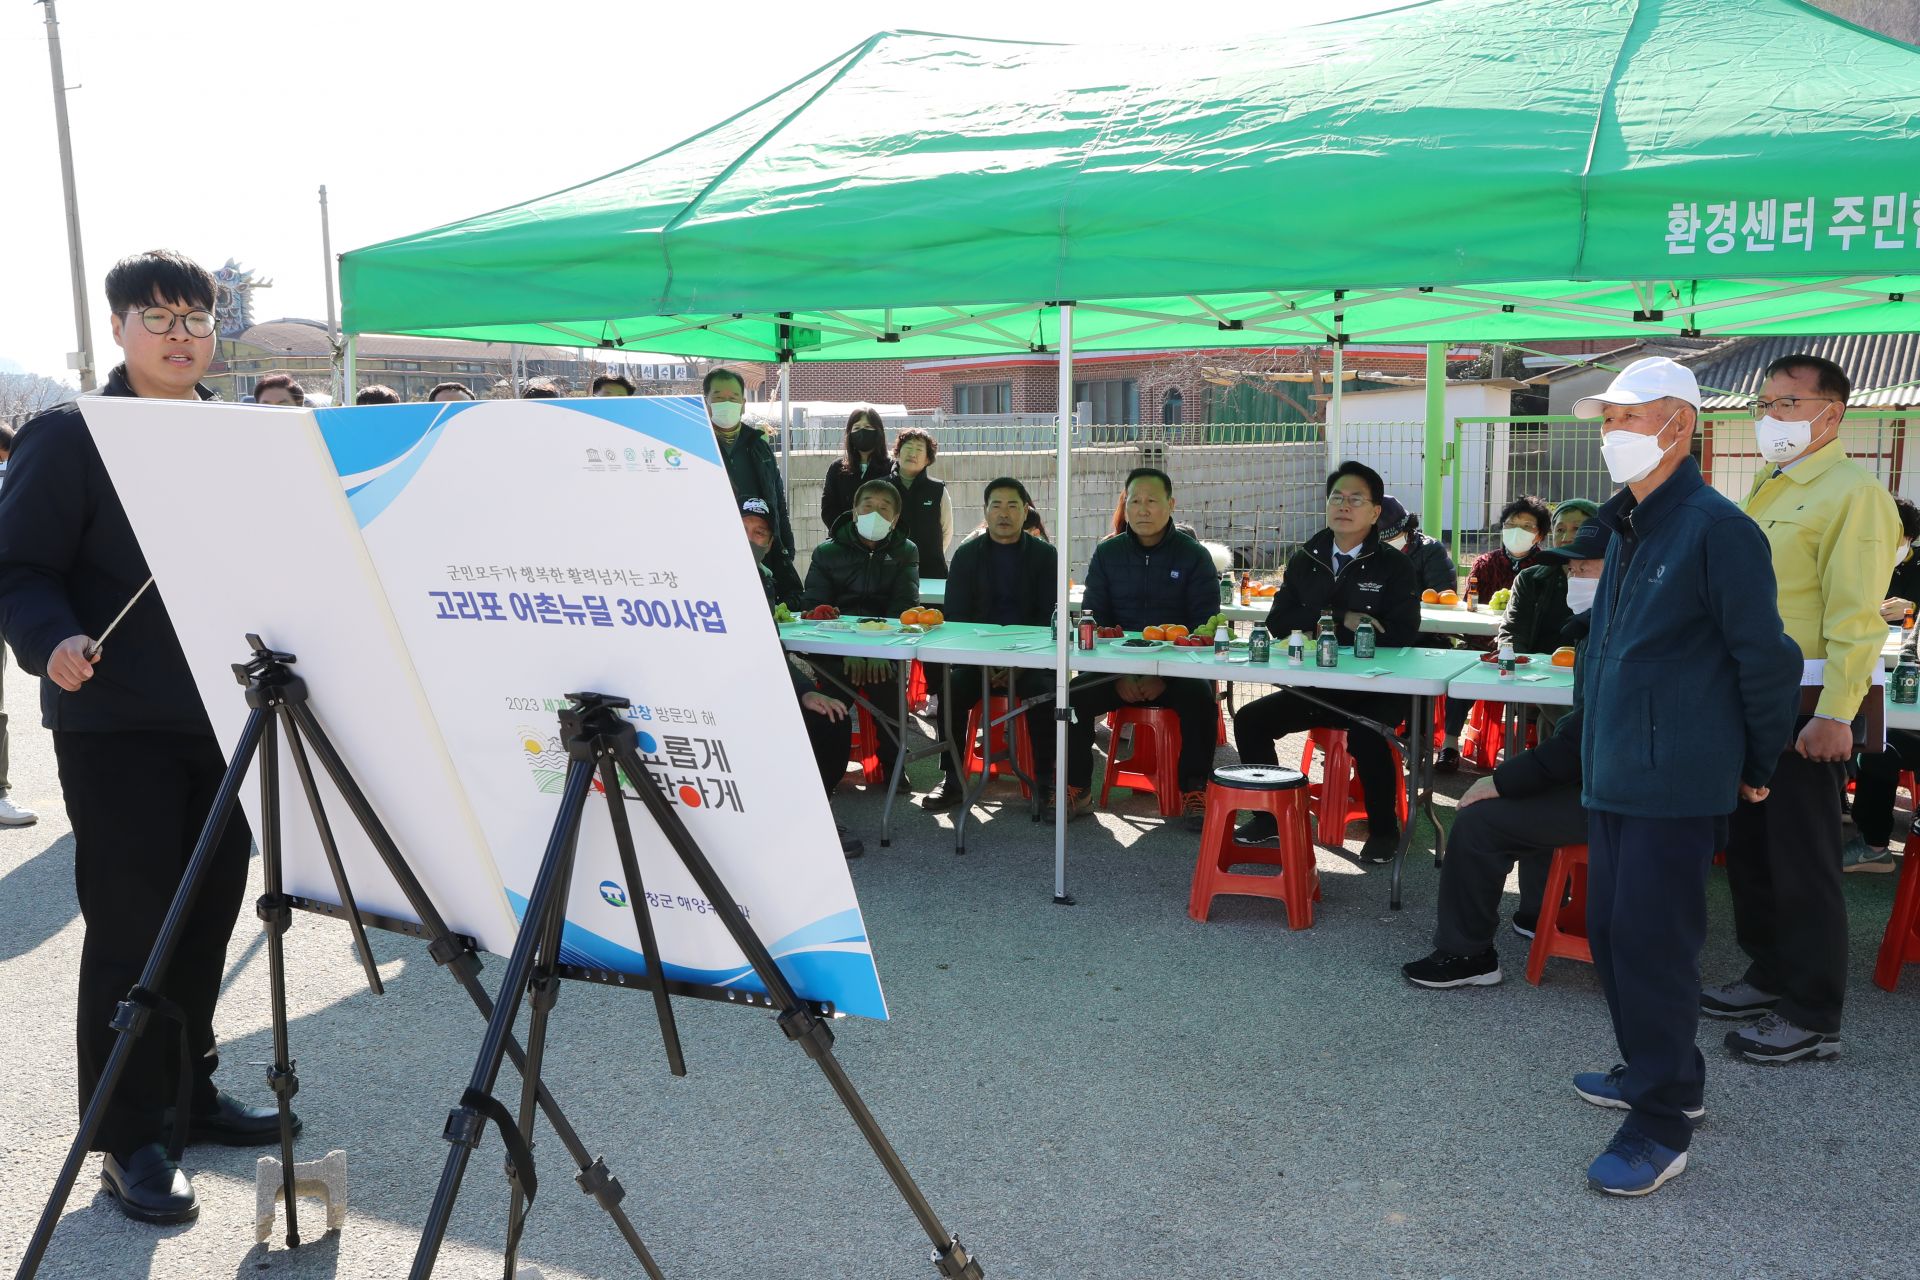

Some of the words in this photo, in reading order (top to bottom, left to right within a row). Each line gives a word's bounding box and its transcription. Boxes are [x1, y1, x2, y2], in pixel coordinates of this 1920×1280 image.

[1664, 196, 1815, 255] 환경센터
[446, 564, 517, 584] 군민모두가
[519, 567, 566, 585] 행복한
[567, 567, 643, 587] 활력넘치는
[648, 570, 678, 589] 고창
[429, 591, 507, 621] 고리포
[509, 592, 614, 627] 어촌뉴딜
[617, 598, 727, 634] 300사업
[505, 696, 539, 712] 2023
[627, 704, 652, 721] 고창
[654, 707, 698, 725] 방문의
[701, 709, 717, 727] 해
[636, 730, 732, 774] 요롭게
[645, 891, 675, 909] 창군
